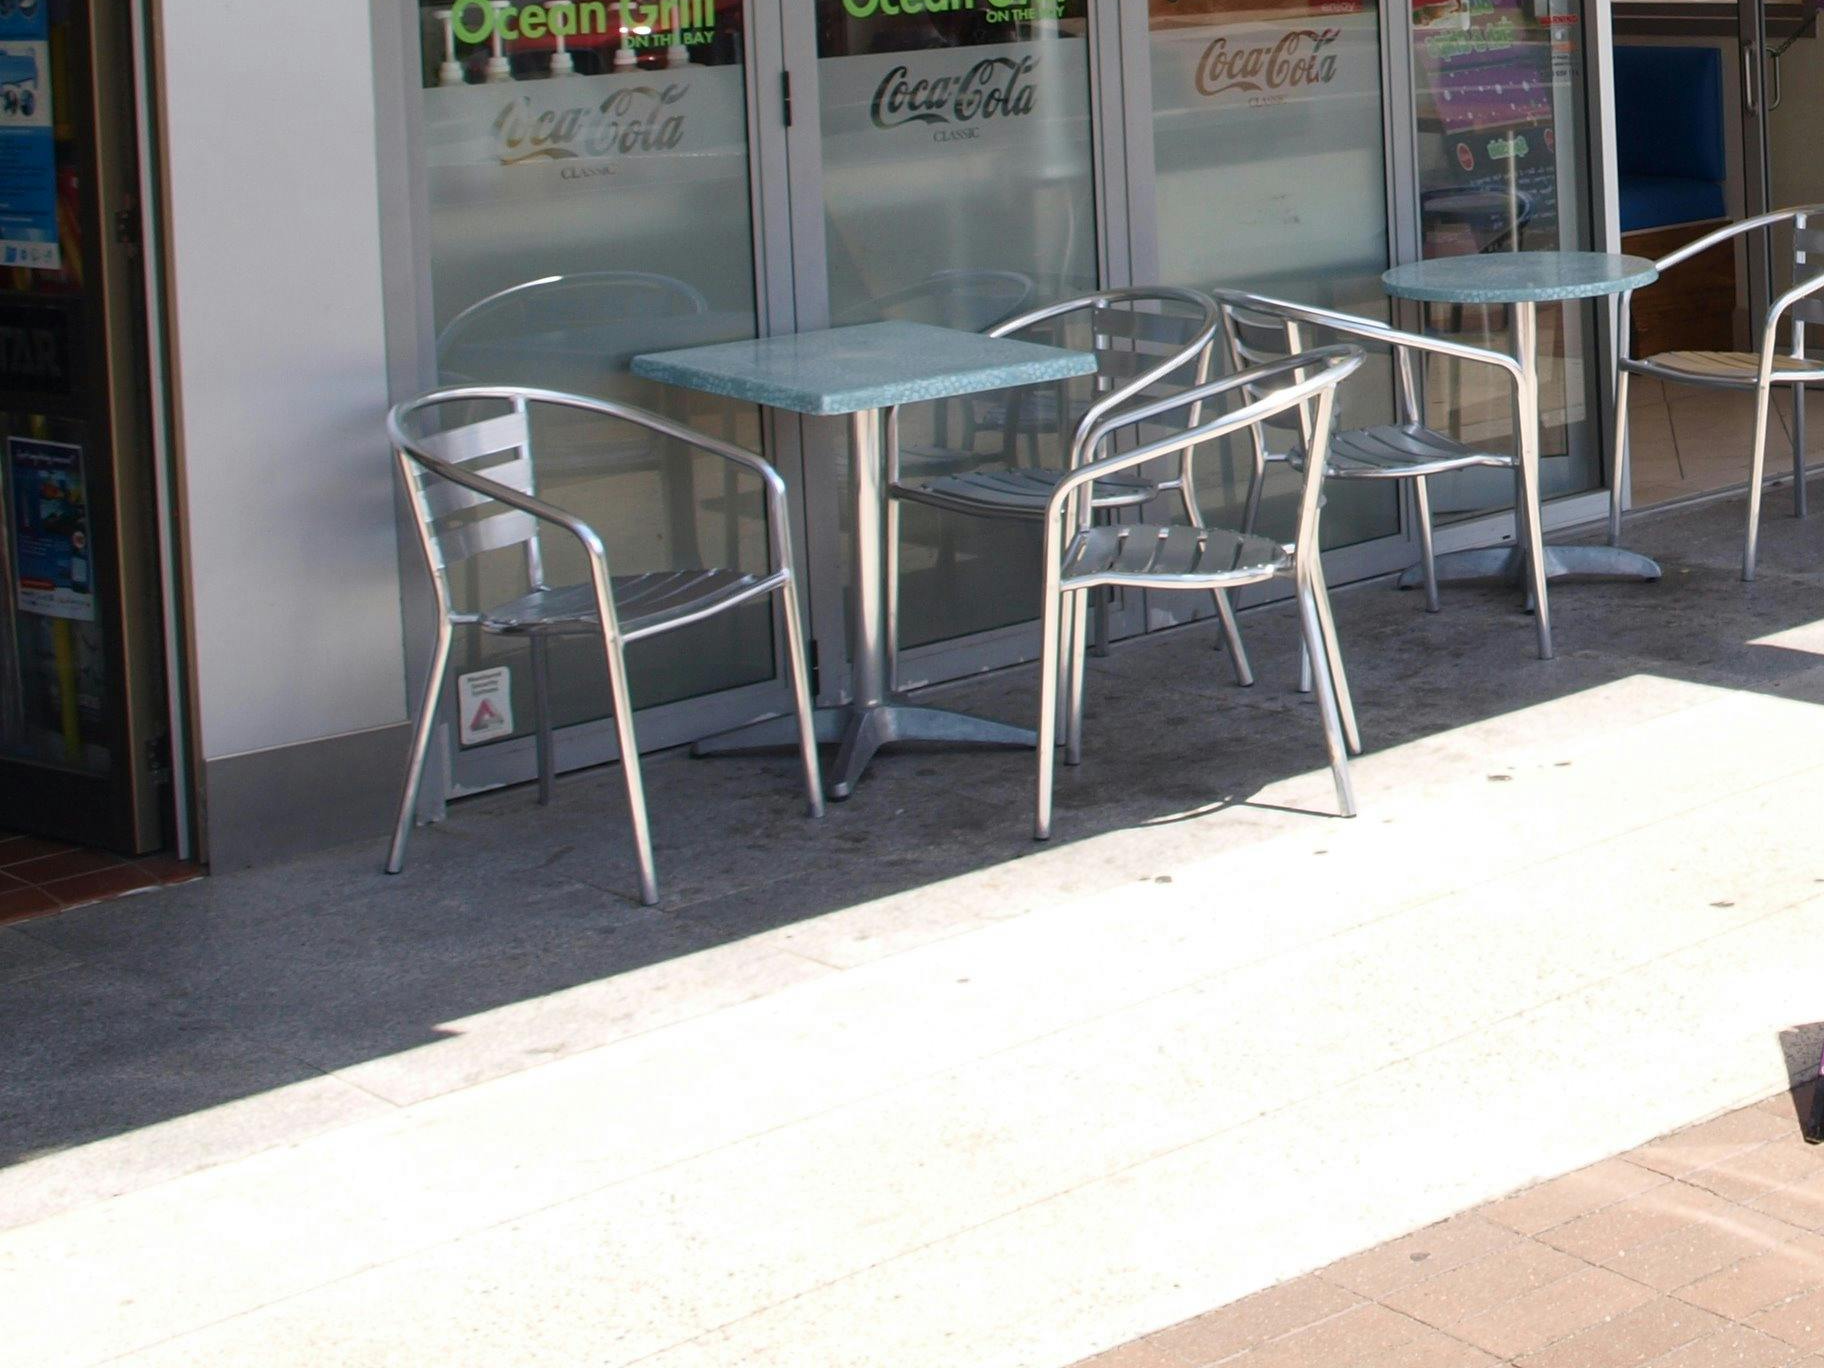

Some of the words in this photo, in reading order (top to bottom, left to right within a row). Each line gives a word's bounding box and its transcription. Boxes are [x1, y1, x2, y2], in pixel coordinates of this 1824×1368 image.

[626, 34, 649, 49] ON
[683, 30, 715, 46] BAY
[986, 9, 1009, 24] ON
[1011, 8, 1036, 22] THE
[870, 55, 1041, 130] Coca-Cola
[1195, 28, 1341, 97] Coca-Cola
[493, 82, 690, 166] Coca-Cola
